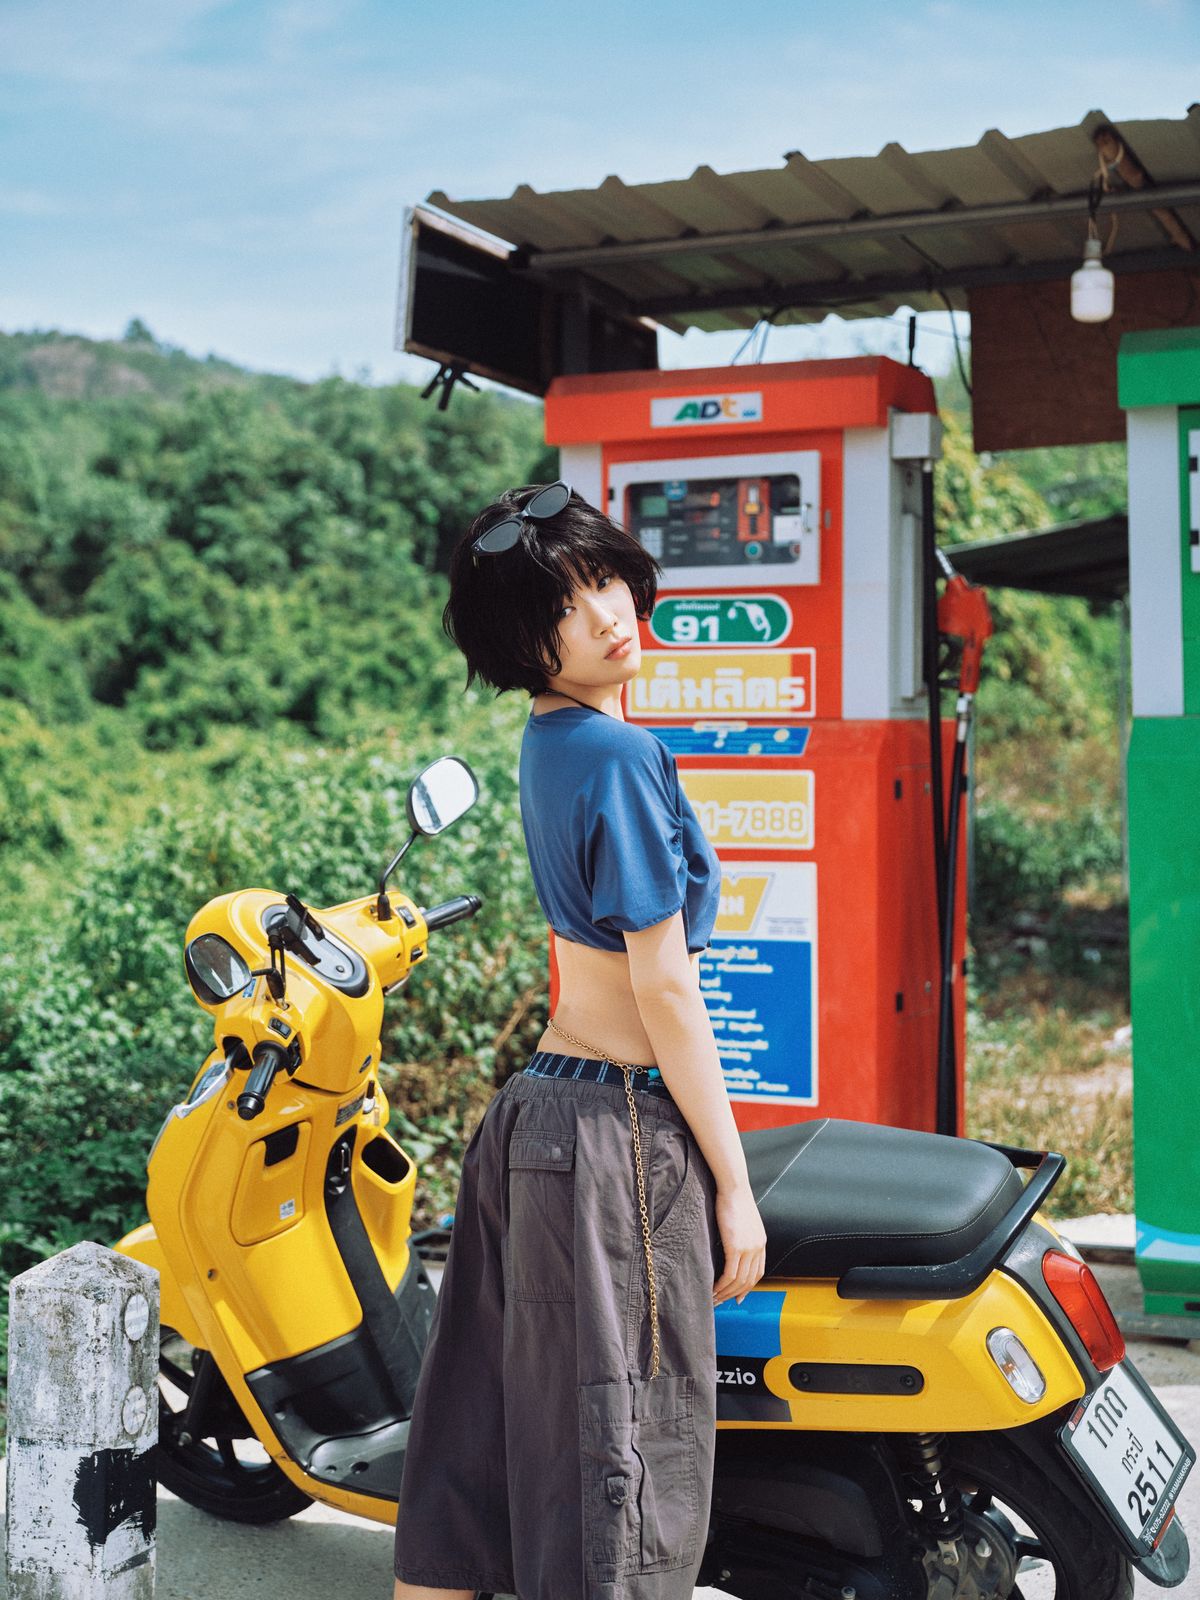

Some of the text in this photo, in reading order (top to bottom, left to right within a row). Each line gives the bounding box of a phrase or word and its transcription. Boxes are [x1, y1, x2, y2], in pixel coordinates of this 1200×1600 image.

[672, 615, 719, 641] 91
[635, 661, 806, 709] เต็มลิตร
[1121, 1427, 1144, 1474] กระบี่
[1127, 1439, 1175, 1527] 2511
